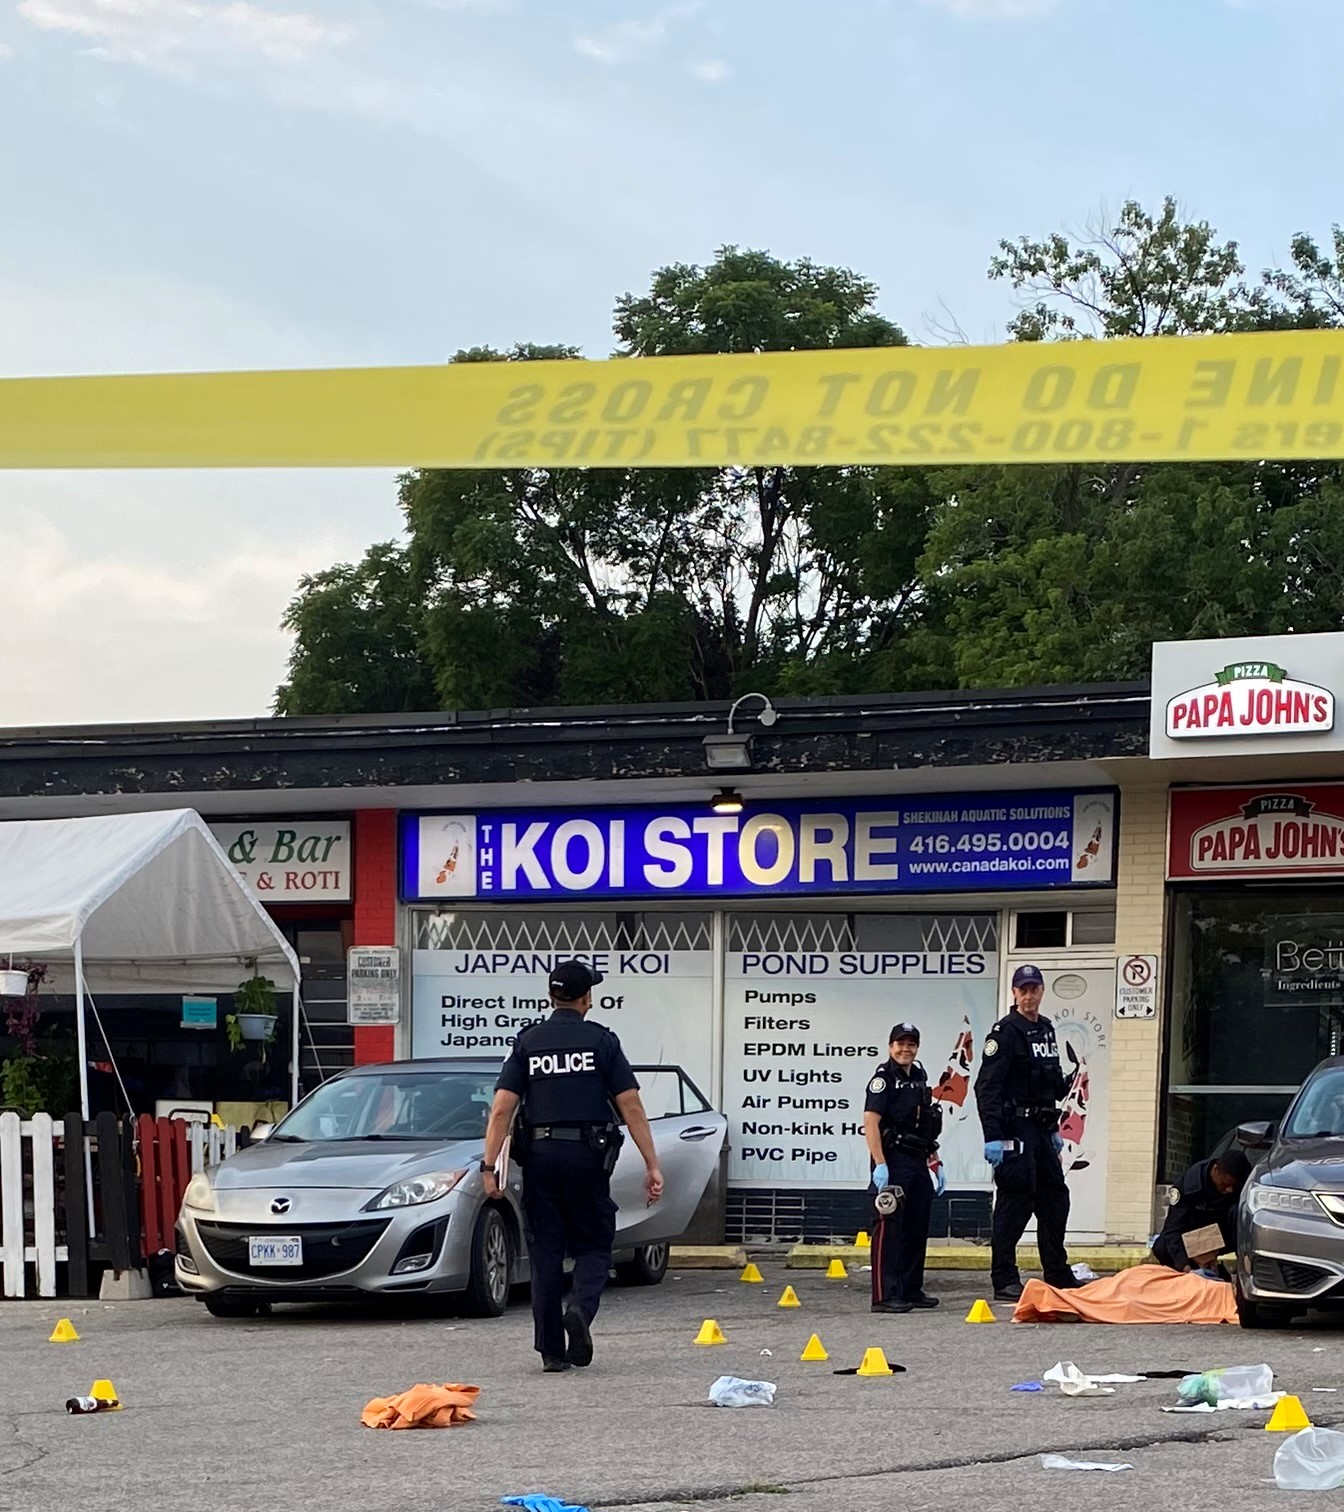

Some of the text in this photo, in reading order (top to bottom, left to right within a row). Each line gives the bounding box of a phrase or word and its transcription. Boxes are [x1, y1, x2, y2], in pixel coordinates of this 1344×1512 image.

[1233, 664, 1269, 678] PIZZA
[1173, 688, 1328, 729] PAPA JOHN'S
[1260, 798, 1295, 811] PIZZA
[903, 810, 959, 824] SHEKINAH
[960, 808, 1007, 823] AQUATIC
[1009, 806, 1071, 821] SOLUTIONS
[228, 829, 342, 864] & Bar
[501, 811, 900, 891] KOI STORE
[910, 831, 1069, 854] 416.495.0004
[1198, 823, 1261, 862] PAPA
[480, 824, 494, 890] THE
[909, 857, 1069, 874] www.canadakoi.com
[256, 871, 275, 890] &
[284, 870, 341, 890] ROTI
[455, 953, 670, 974] JAPANE KOI
[742, 953, 986, 975] POND SUPPLIES
[1277, 979, 1341, 992] Ingredients
[441, 995, 505, 1010] Direct
[600, 995, 624, 1010] Of
[745, 990, 817, 1007] Pumps
[441, 1015, 546, 1031] High Grad
[744, 1016, 811, 1030] Filters
[1053, 1008, 1107, 1050] KOI STORE
[440, 1033, 515, 1049] Japane
[743, 1043, 879, 1057] EPDM Liners
[529, 1052, 596, 1076] POLICE
[743, 1069, 842, 1086] UV Lights
[741, 1095, 850, 1112] Air Pumps
[742, 1121, 835, 1136] Non-kink
[741, 1147, 838, 1165] PVC Pipe
[251, 1244, 299, 1258] CPKK 987
